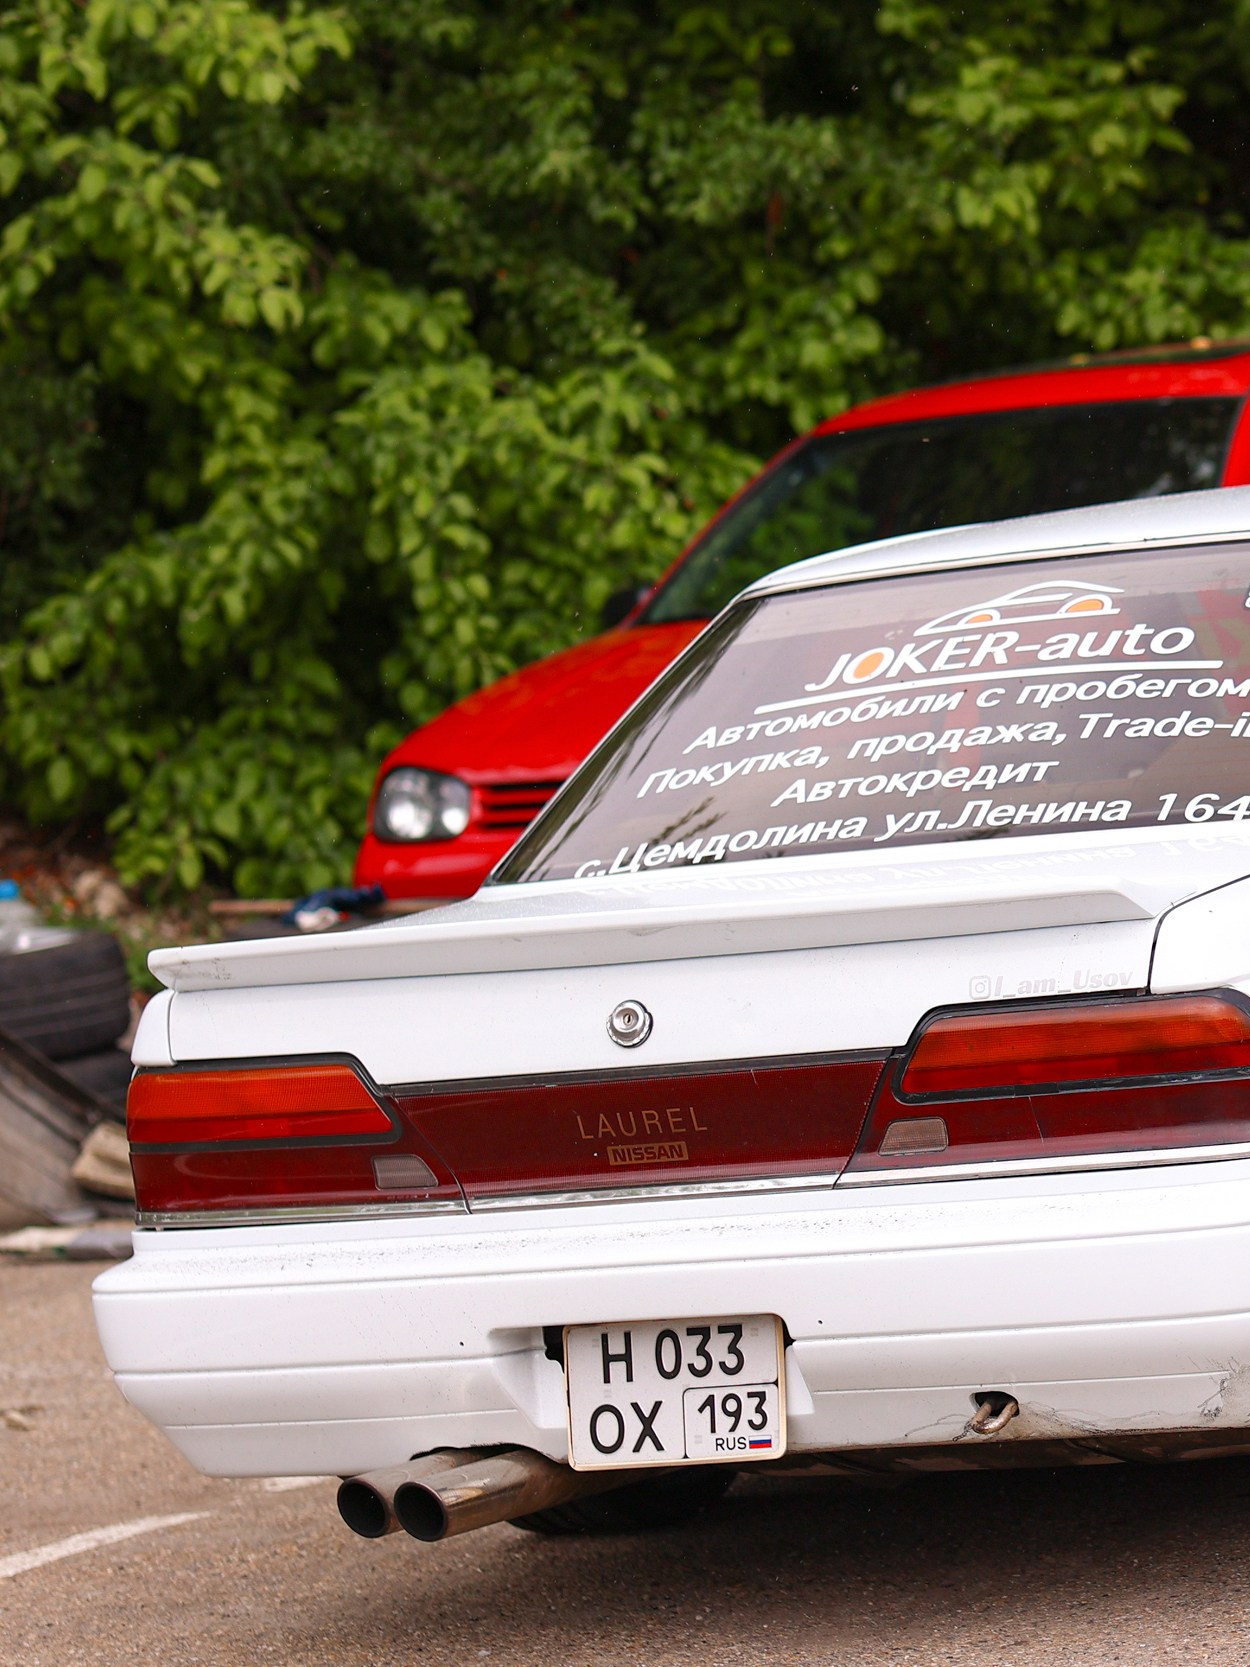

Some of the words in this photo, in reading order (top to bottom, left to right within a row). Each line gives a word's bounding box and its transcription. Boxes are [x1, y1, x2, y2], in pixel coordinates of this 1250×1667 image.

[804, 623, 1195, 692] JOKER-auto
[683, 690, 964, 755] Автомобили
[977, 686, 1006, 708] с
[637, 745, 830, 799] Покупка,
[847, 719, 1067, 763] продажа,
[771, 759, 1060, 808] Автокредит
[574, 814, 867, 879] с.Цемдолина
[873, 797, 1132, 842] ул.Ленина
[576, 1106, 708, 1140] LAUREL
[611, 1143, 685, 1164] NISSAN
[655, 1324, 745, 1380] 033
[697, 1391, 768, 1433] 193
[715, 1437, 748, 1452] RUS
